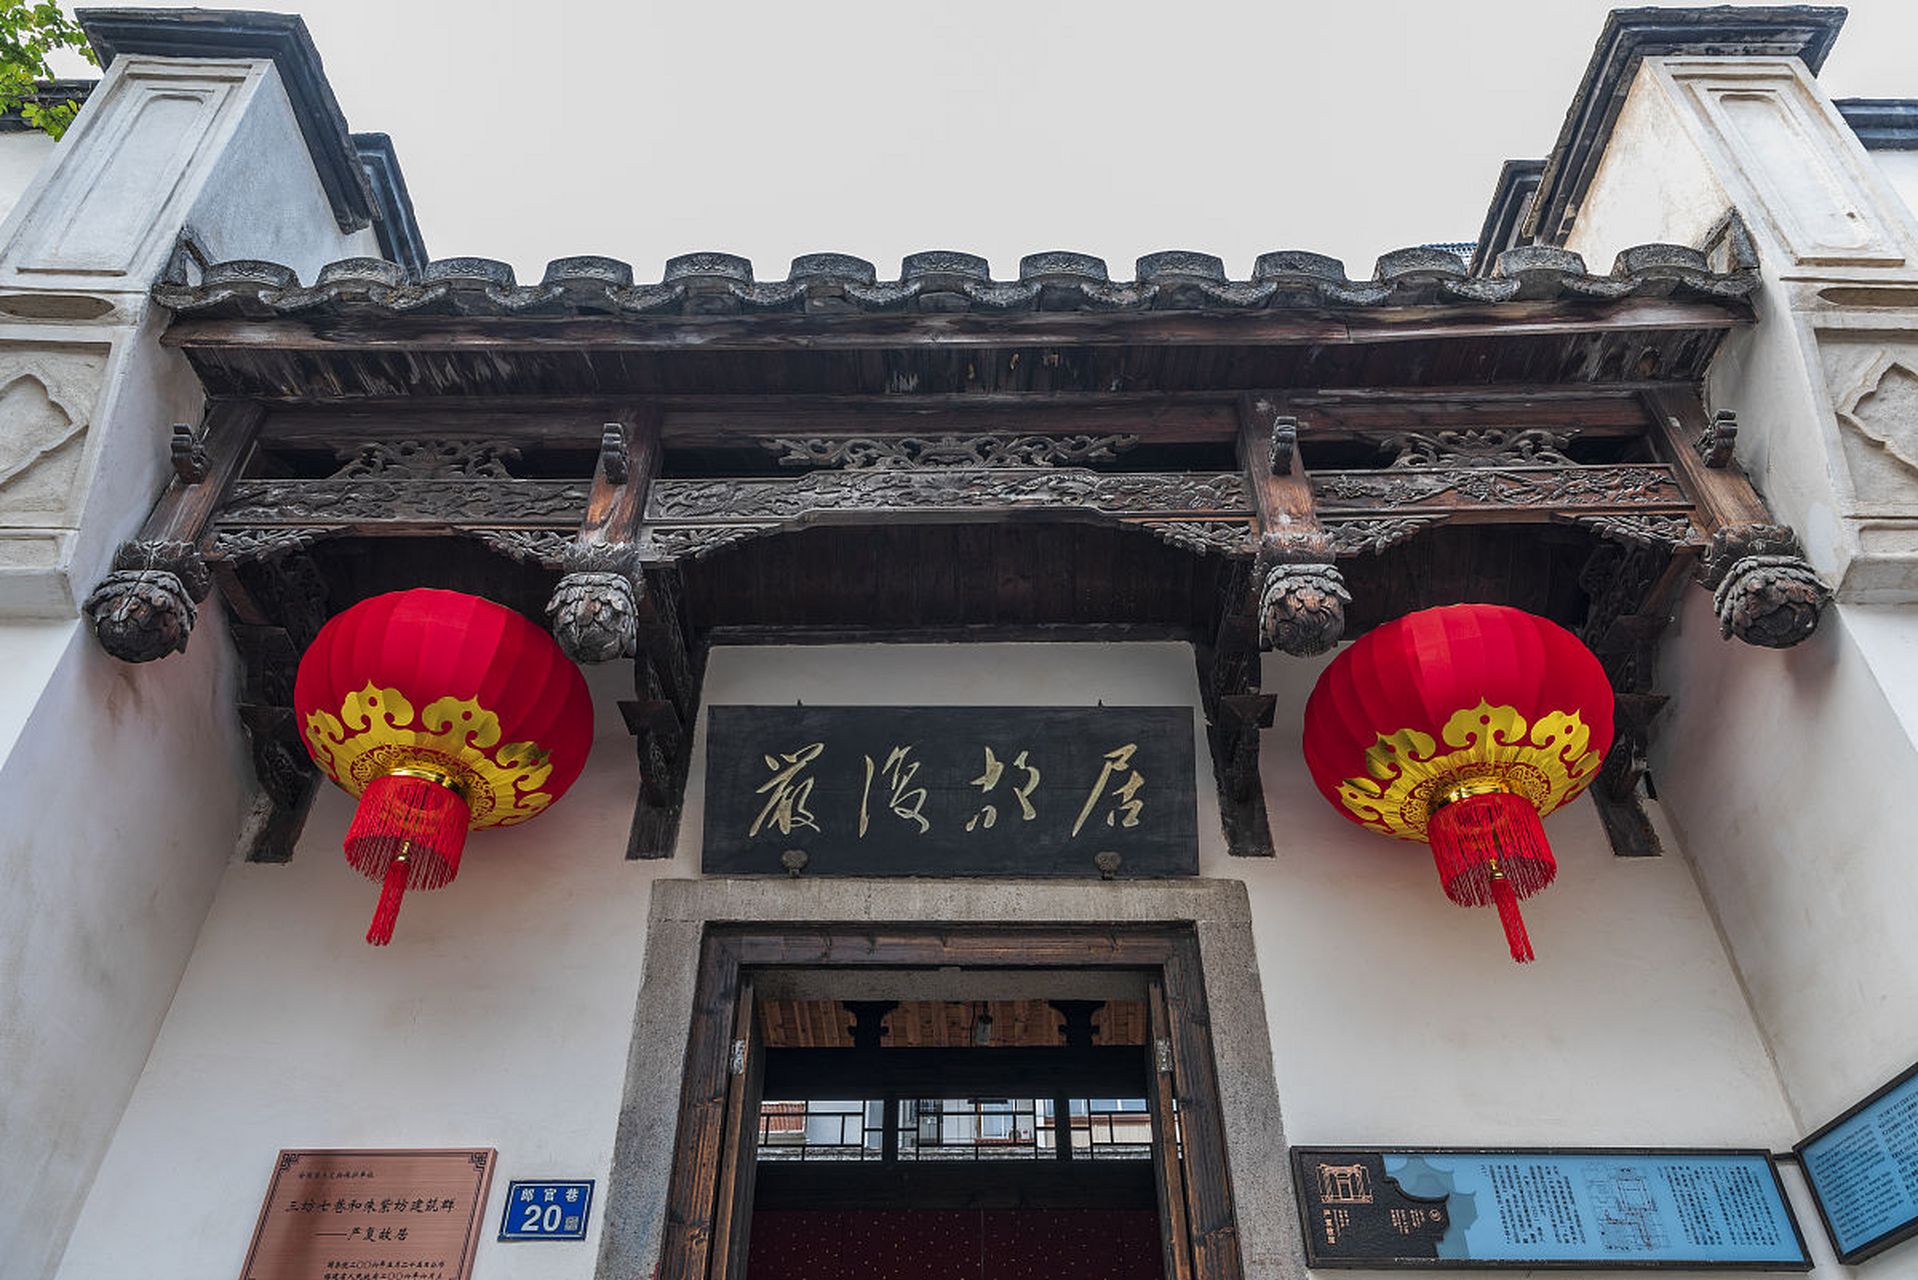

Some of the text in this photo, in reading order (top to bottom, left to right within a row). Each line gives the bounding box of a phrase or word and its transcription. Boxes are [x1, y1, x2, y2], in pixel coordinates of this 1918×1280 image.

[749, 742, 1144, 838] 嚴復故居
[520, 1188, 579, 1202] 郎官巷
[520, 1204, 562, 1232] 20
